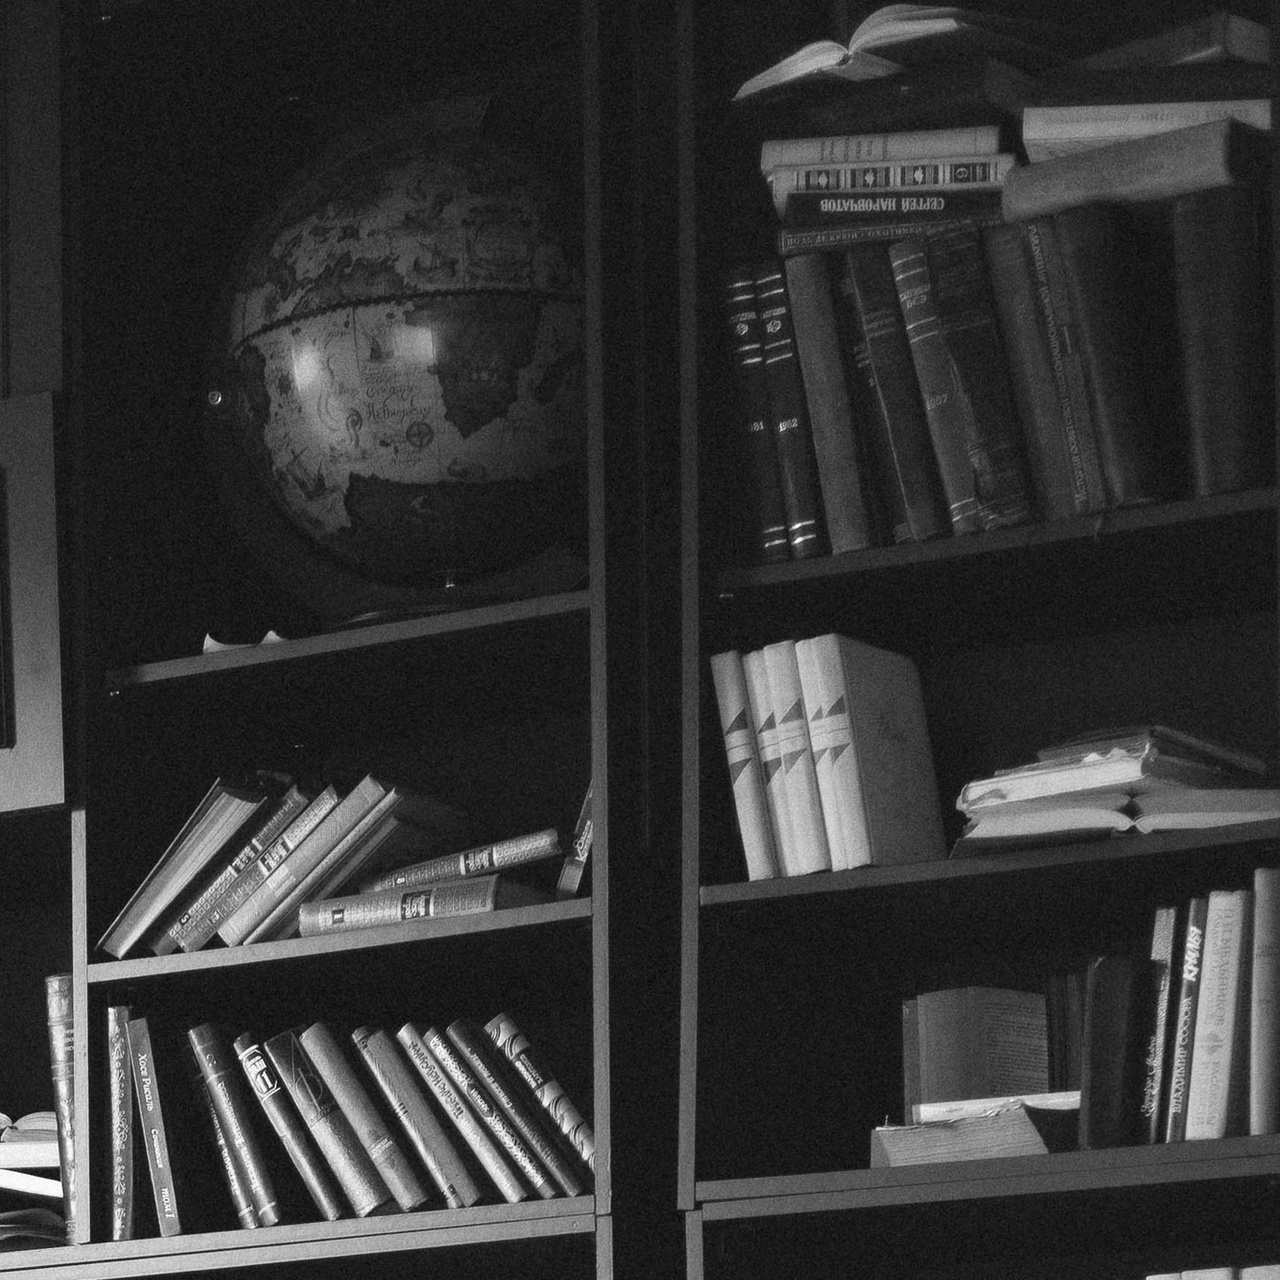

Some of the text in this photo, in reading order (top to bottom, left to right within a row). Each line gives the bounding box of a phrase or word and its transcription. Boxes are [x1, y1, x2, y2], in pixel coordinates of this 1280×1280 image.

[819, 195, 944, 214] СЕРГЕЙ НАРОВЧАТОВ
[1066, 454, 1088, 503] ИСТОРИЯ
[1180, 925, 1206, 981] КРЫЛЬЯ
[137, 1052, 150, 1076] Хосе
[1169, 995, 1195, 1113] ВЛАДИМИР СОСЮРА
[141, 1077, 156, 1111] Рисаль
